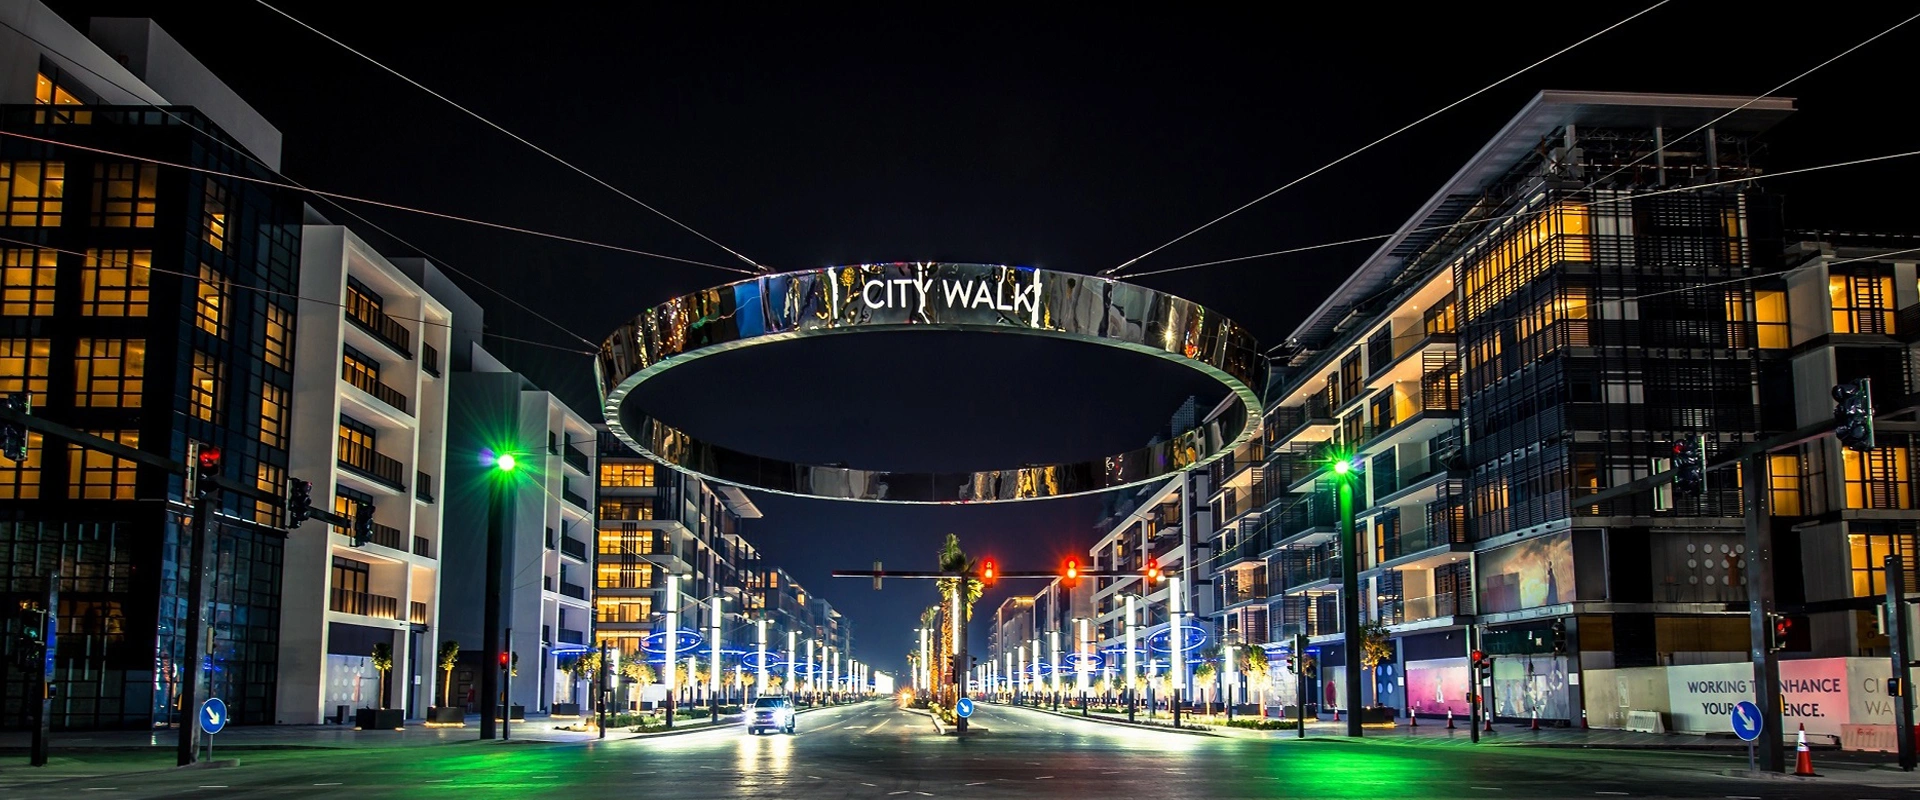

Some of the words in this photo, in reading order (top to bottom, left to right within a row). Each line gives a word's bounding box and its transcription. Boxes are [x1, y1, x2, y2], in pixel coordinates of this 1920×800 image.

[863, 279, 934, 309] CITY
[942, 280, 1037, 312] WALK
[1687, 680, 1747, 694] WORKING
[1779, 679, 1841, 693] NHANCE
[1863, 678, 1880, 693] CI
[1865, 700, 1894, 715] WA
